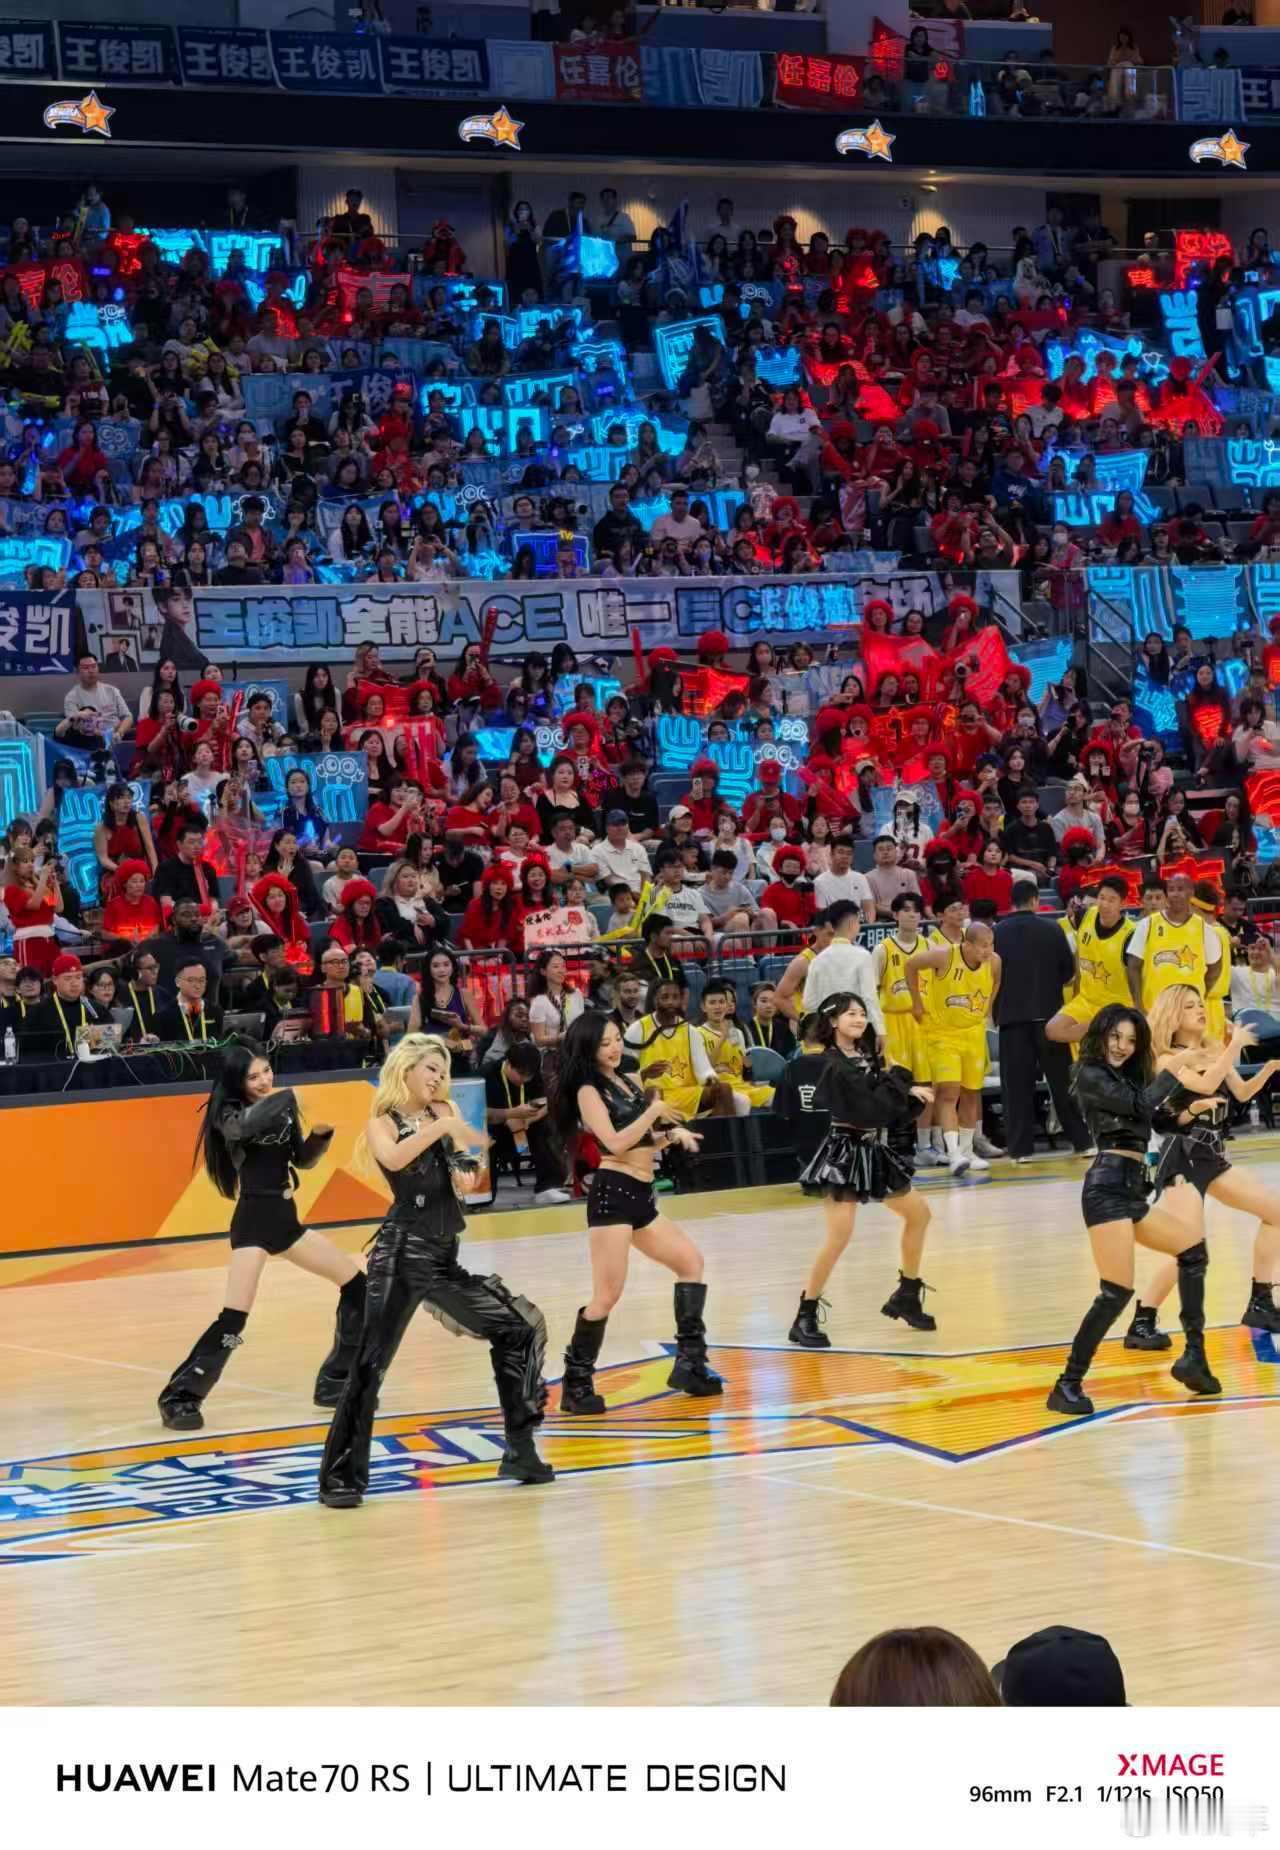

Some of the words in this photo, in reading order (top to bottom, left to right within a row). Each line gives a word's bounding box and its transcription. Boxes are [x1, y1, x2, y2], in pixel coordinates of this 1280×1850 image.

[65, 36, 164, 74] 王俊凯
[184, 41, 272, 80] 王俊凯
[278, 46, 377, 81] 王俊凯
[389, 47, 482, 83] 王俊凯
[559, 54, 640, 87] 任嘉伦
[777, 53, 859, 97] 任嘉伦
